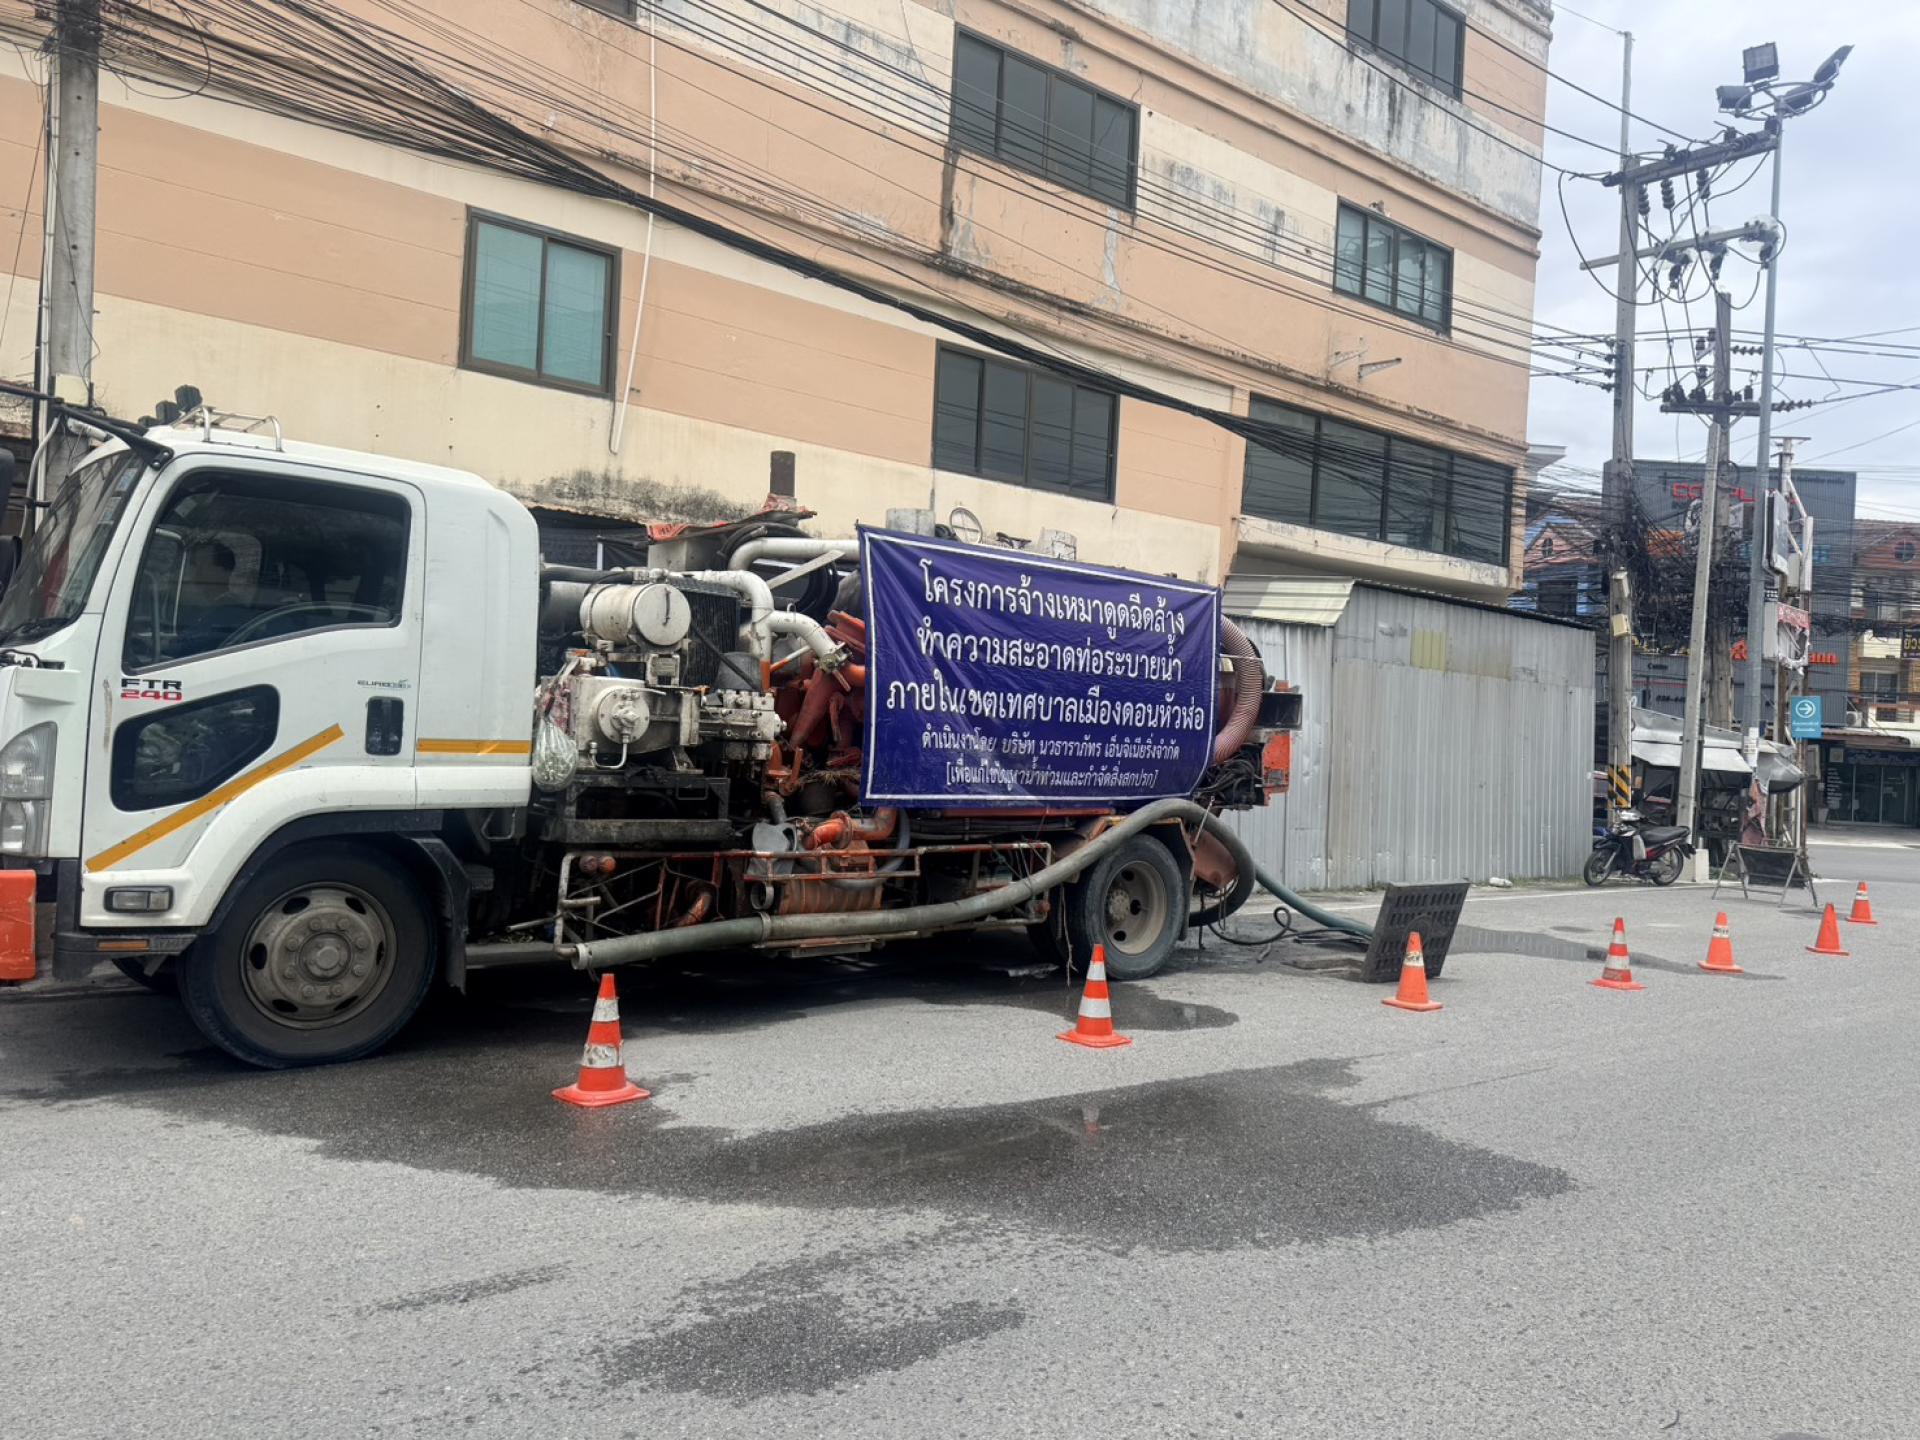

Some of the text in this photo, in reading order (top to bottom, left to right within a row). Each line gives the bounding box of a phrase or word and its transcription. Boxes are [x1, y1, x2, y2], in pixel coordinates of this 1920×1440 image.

[919, 558, 1185, 640] โครงการจ้างเหมาดูดฉีดล้าง
[916, 615, 1182, 682] ทำความสะอาดท่อระบายน้ำ
[121, 678, 182, 690] FTR
[121, 689, 182, 701] 240
[886, 668, 1205, 731] ภายในเขตเทศบาลเมืองดอนหัวฬ่อ
[1002, 730, 1035, 755] บริษัท
